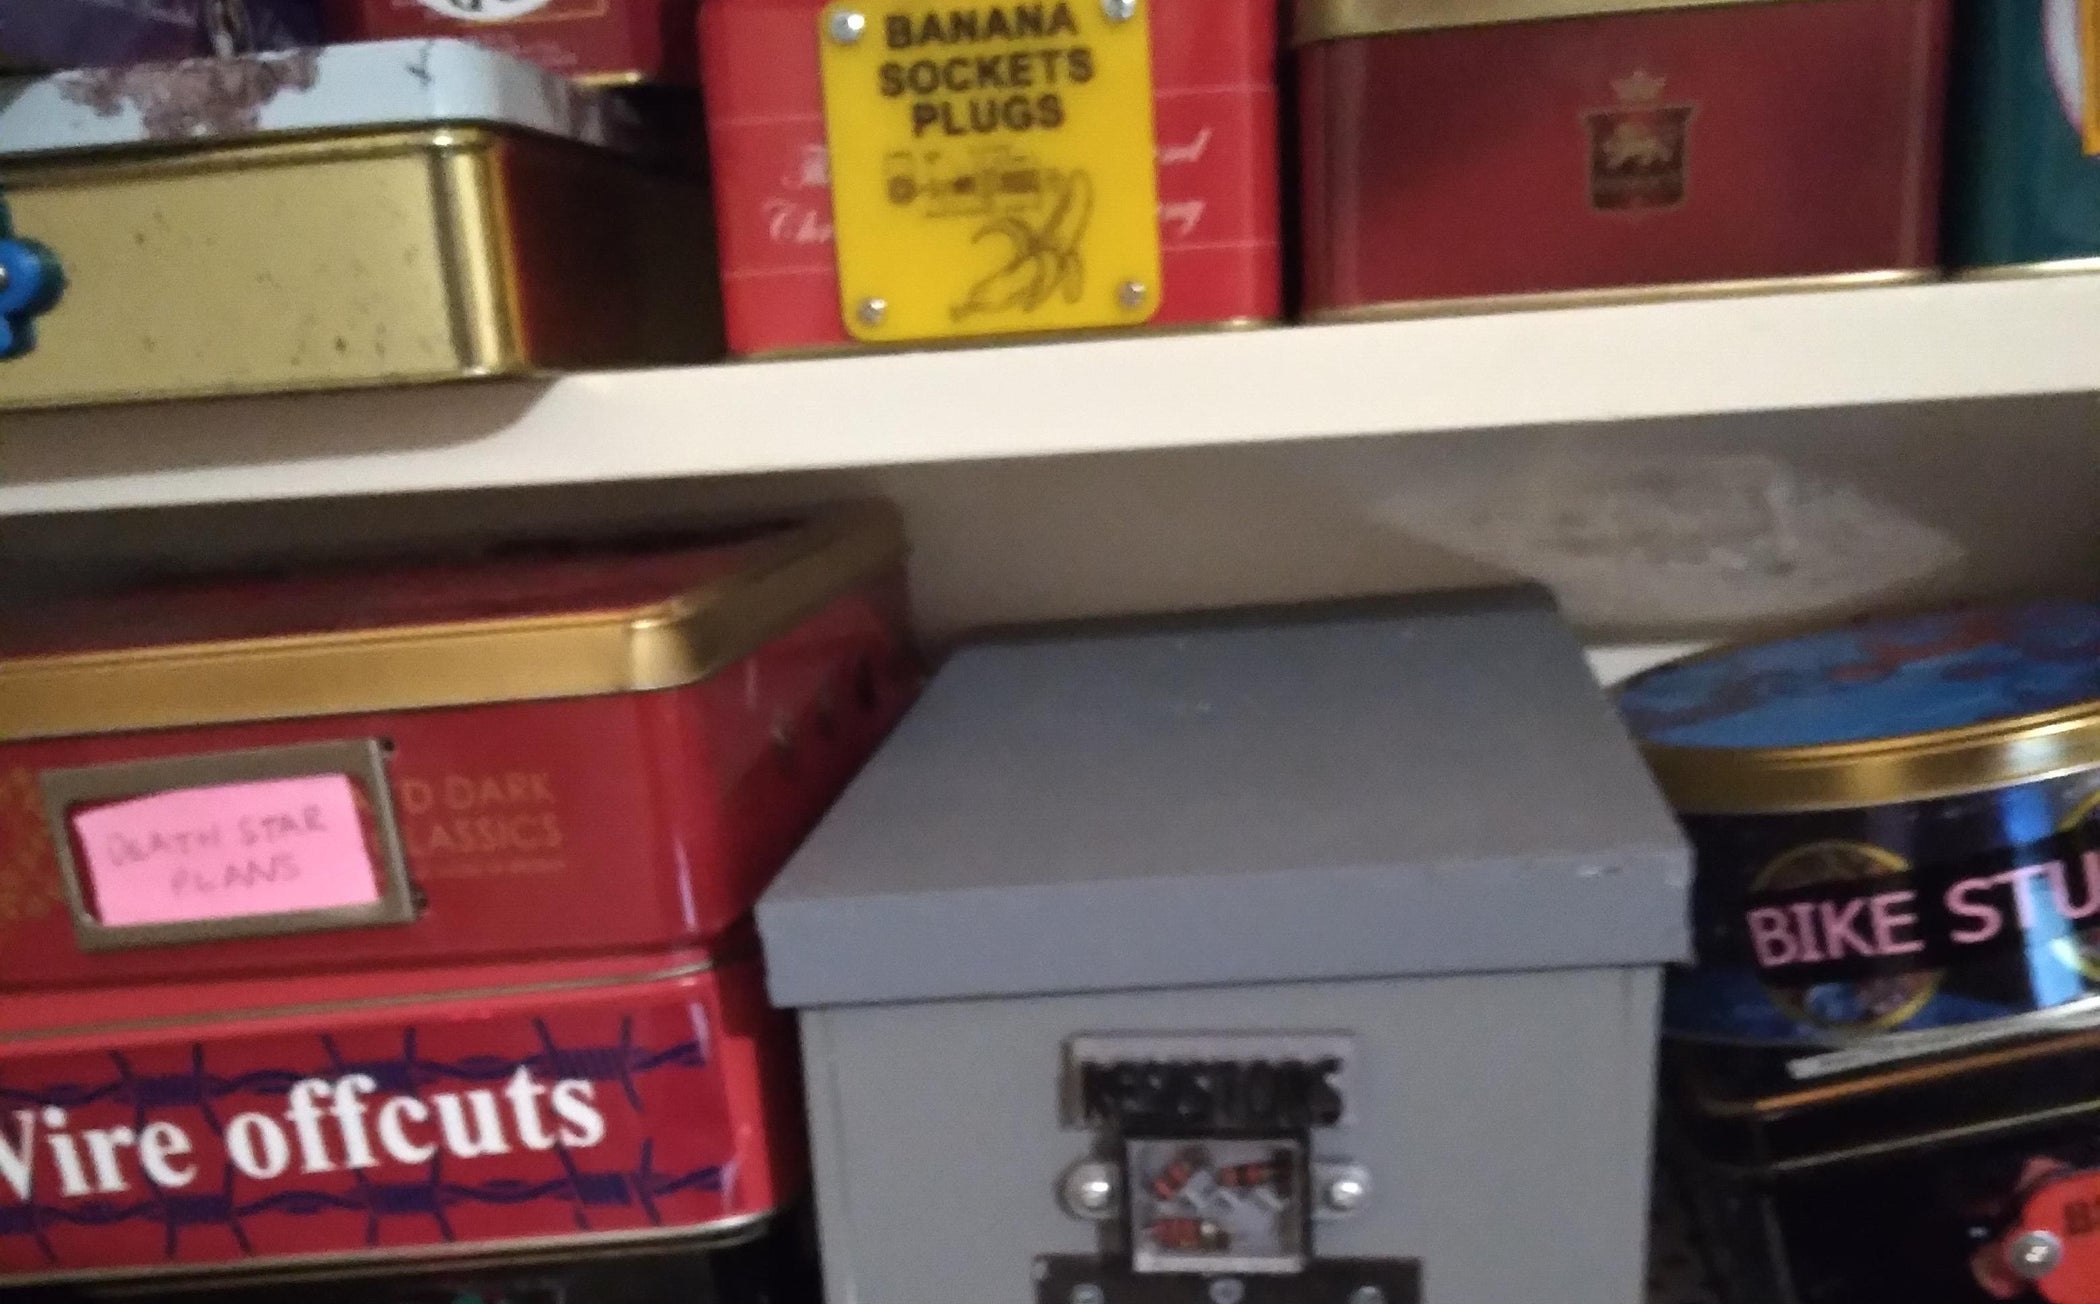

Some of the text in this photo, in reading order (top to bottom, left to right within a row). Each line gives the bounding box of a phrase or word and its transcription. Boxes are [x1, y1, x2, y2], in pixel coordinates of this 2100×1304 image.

[885, 3, 1078, 49] BANANA
[879, 47, 1094, 98] SOCKETS
[911, 93, 1065, 138] PLUGS
[444, 771, 555, 811] DARK
[106, 803, 328, 868] DEATH STAR
[405, 810, 566, 857] LASSICS
[168, 852, 299, 896] PLANS
[1746, 889, 1925, 968] BIKE
[0, 1063, 606, 1203] ire offcuts
